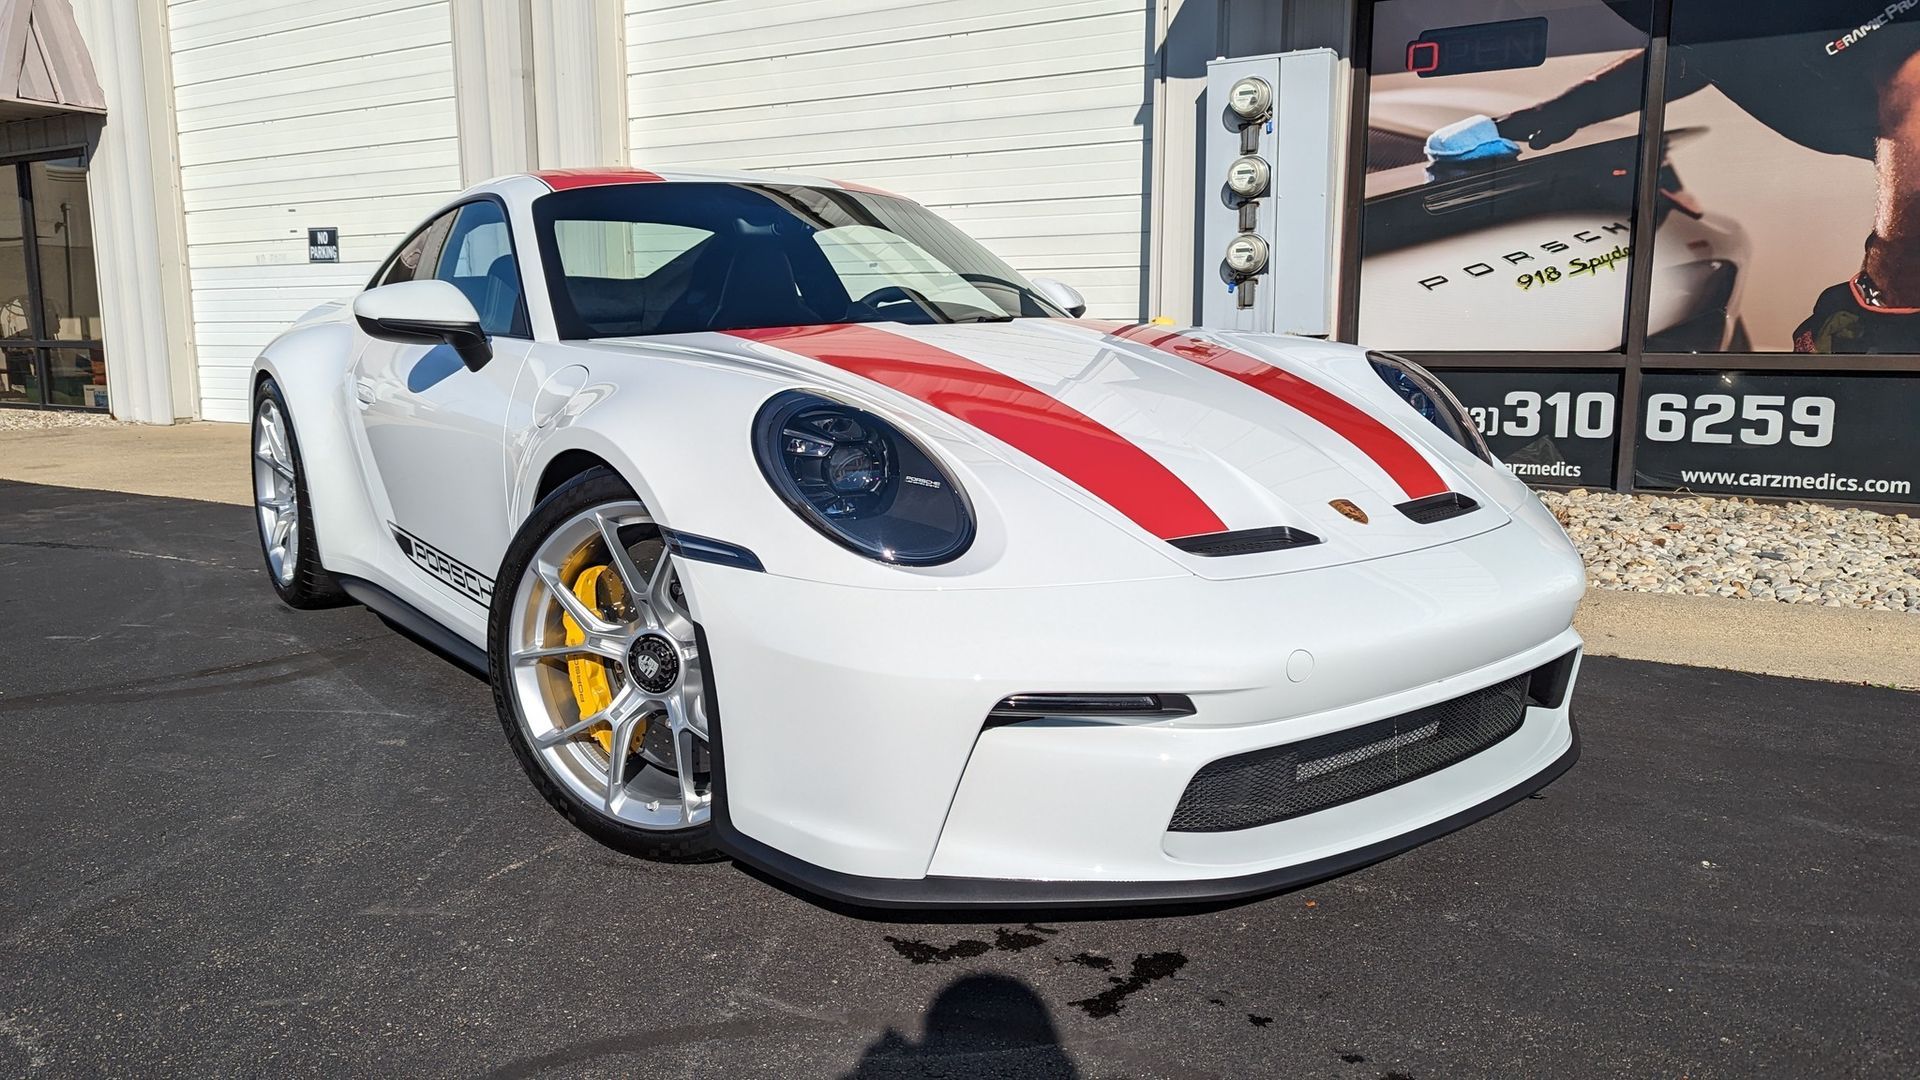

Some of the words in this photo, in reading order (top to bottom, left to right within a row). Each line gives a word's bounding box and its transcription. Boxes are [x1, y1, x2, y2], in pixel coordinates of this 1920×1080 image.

[310, 246, 337, 259] PARKING
[316, 231, 329, 244] NO
[1418, 217, 1631, 291] PORSCH
[1516, 265, 1562, 290] 918
[1568, 245, 1633, 278] Spyde
[1503, 390, 1615, 439] 310
[1645, 393, 1836, 448] 6259
[1505, 461, 1582, 478] arzmedics
[1681, 470, 1911, 494] www.carzmedics.com
[414, 541, 494, 600] PORSCH
[570, 638, 585, 703] PORSCE
